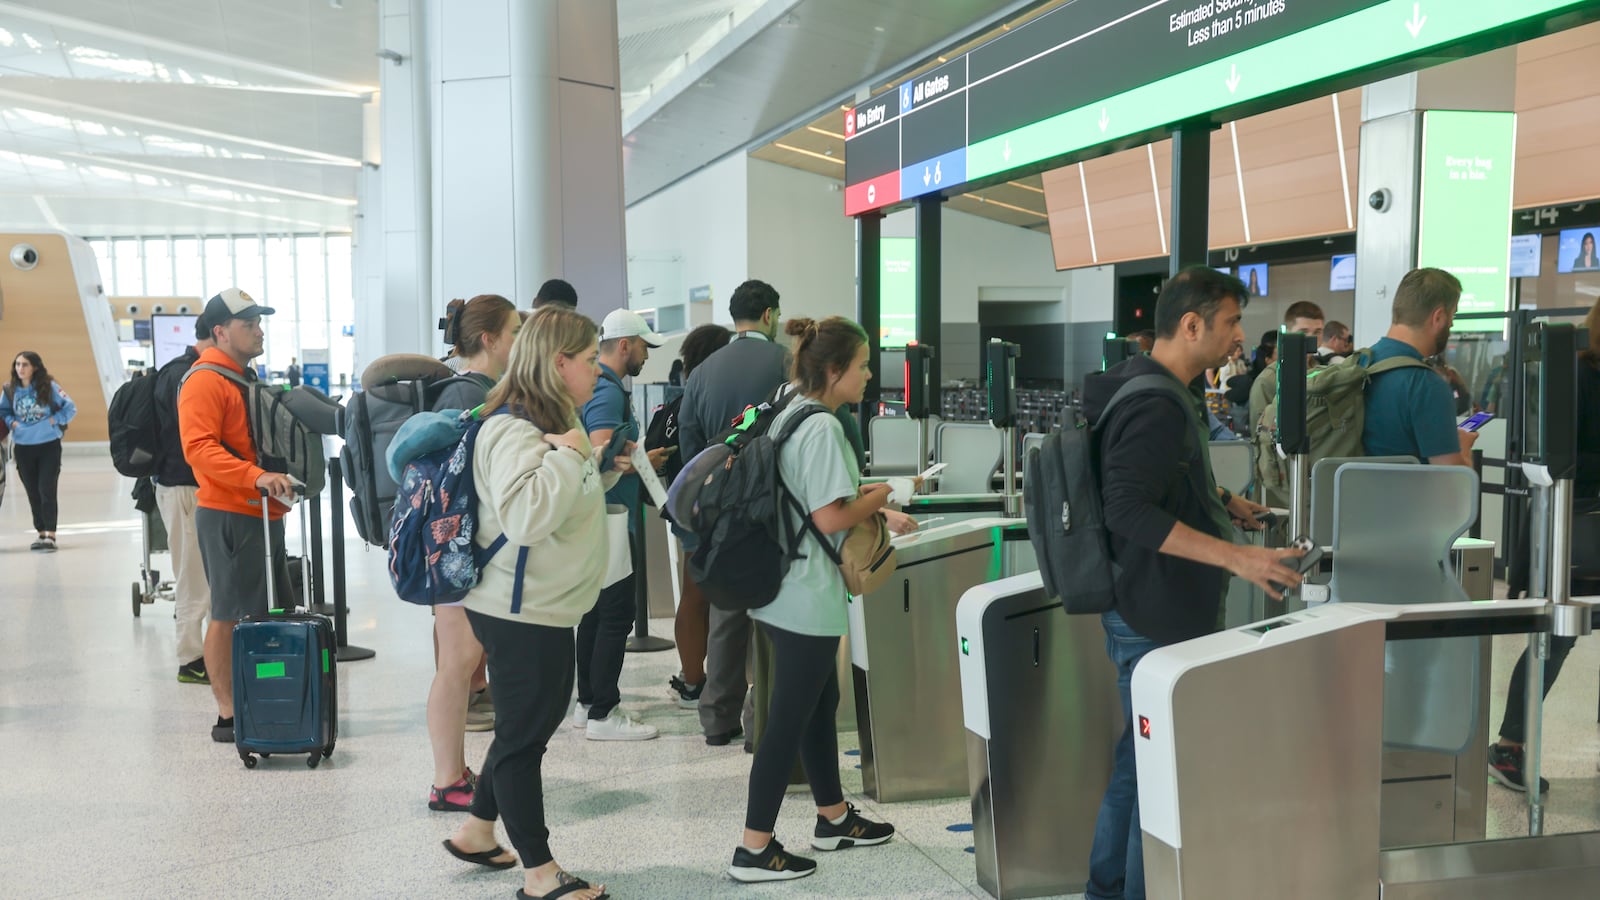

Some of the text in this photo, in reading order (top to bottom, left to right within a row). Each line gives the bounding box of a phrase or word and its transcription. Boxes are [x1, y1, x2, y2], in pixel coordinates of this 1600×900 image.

[1169, 0, 1254, 33] Estimated Secu
[1188, 0, 1285, 47] Less than 5 minutes
[913, 75, 949, 104] All Gates
[857, 104, 886, 129] No Entry
